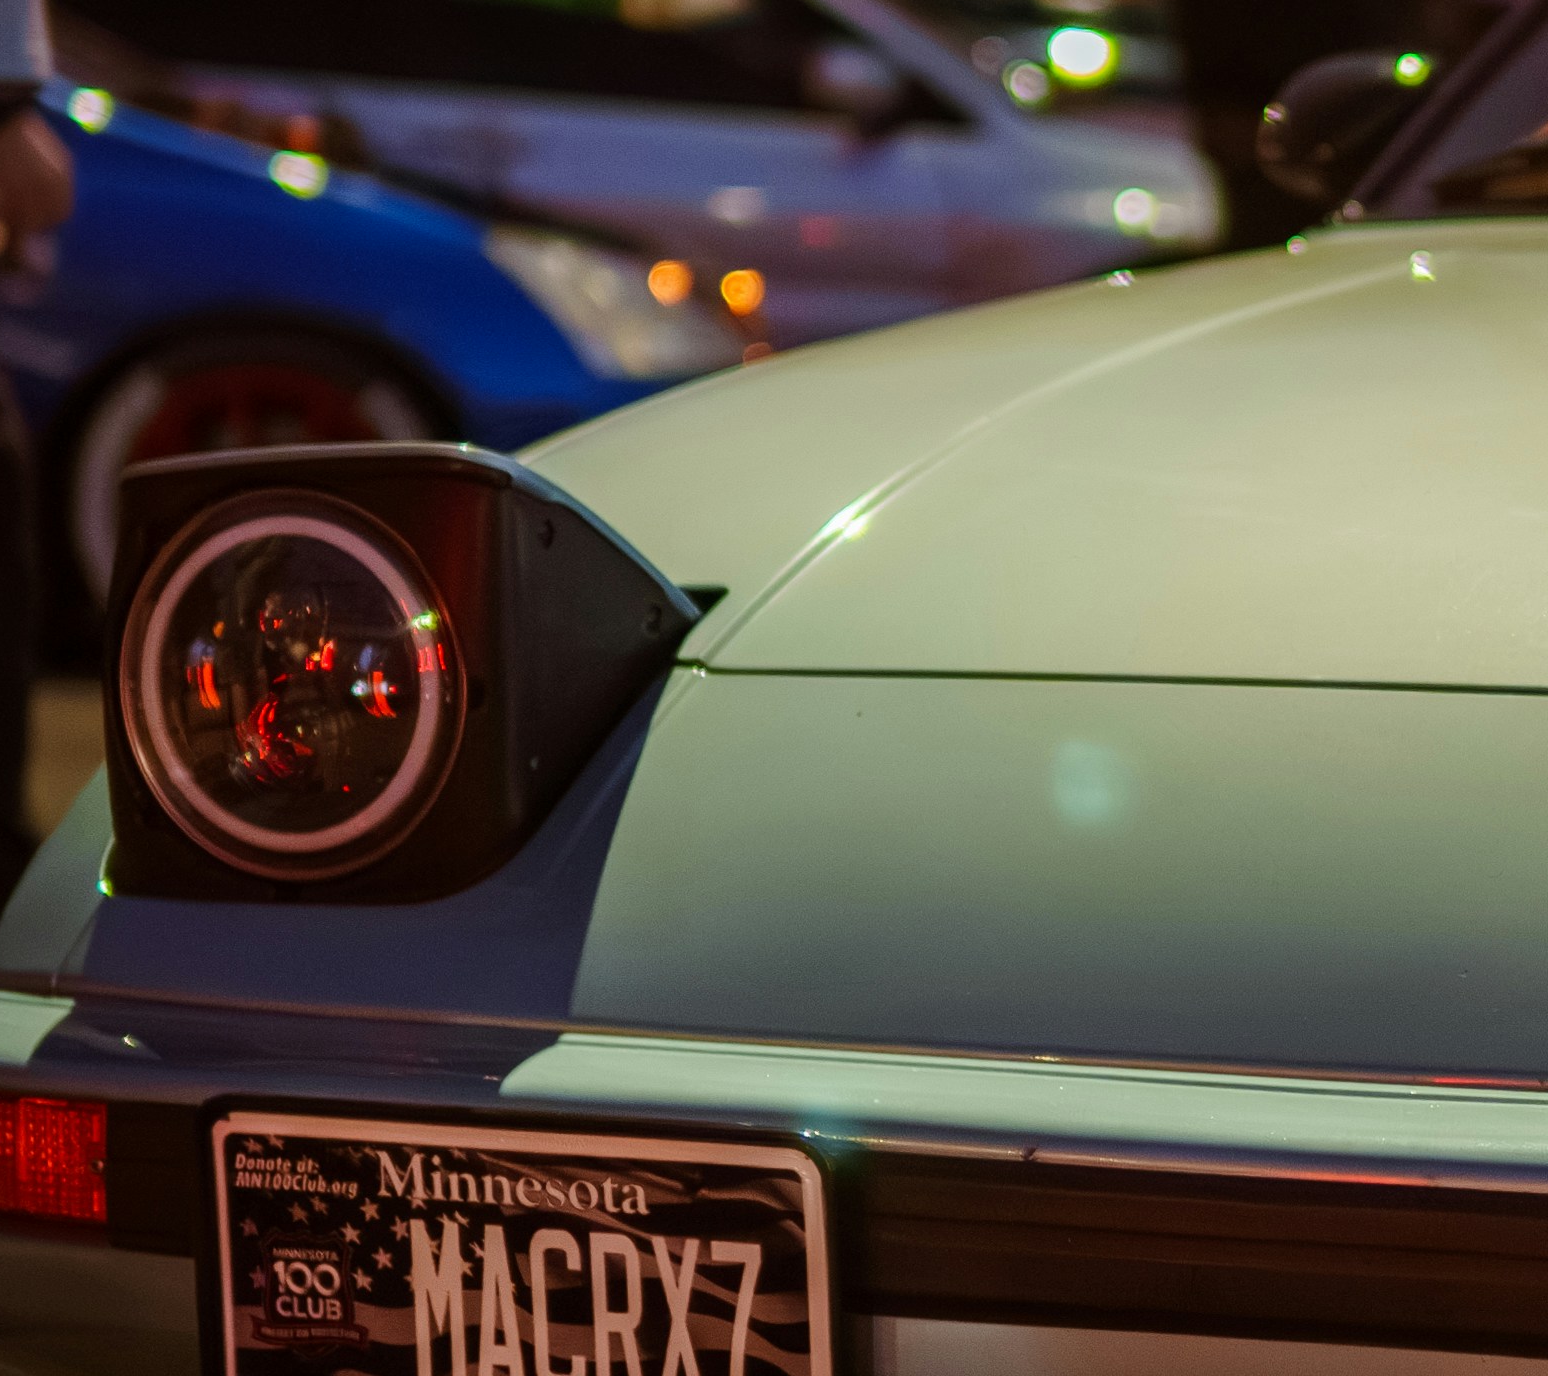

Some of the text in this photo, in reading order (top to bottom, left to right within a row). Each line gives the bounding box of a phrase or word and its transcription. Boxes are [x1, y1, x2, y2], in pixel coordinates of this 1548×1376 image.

[235, 1152, 320, 1174] Donate at:
[235, 1171, 358, 1199] MN100Club.org
[377, 1149, 650, 1215] Minnesota
[273, 1260, 341, 1297] 100
[275, 1295, 342, 1321] CLUB
